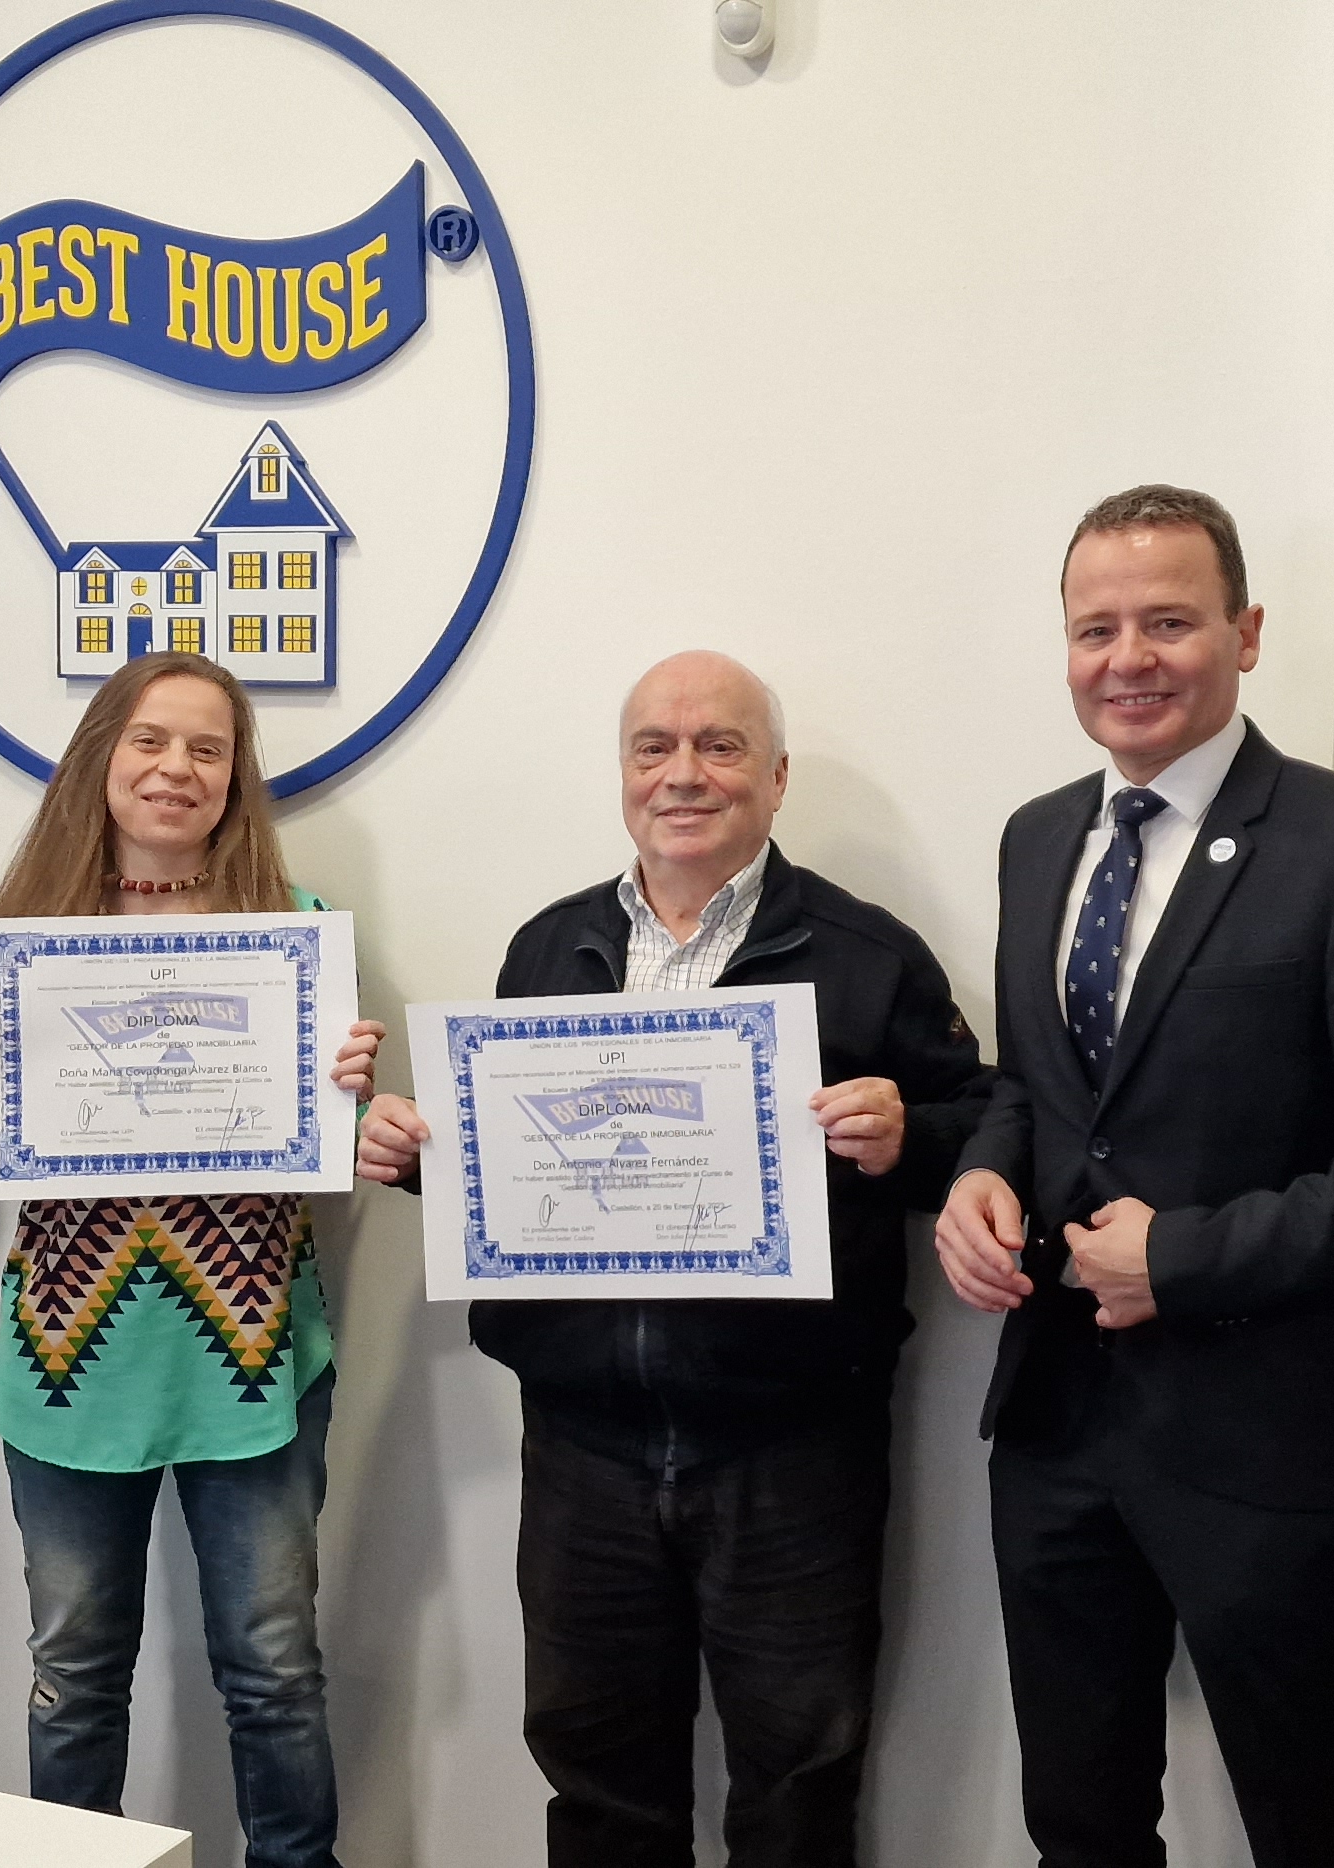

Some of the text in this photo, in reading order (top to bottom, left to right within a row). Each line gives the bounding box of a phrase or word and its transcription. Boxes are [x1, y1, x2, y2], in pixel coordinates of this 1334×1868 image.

[165, 232, 388, 363] HOUSE
[150, 968, 176, 980] UPI
[127, 1015, 200, 1027] DIPLOMA
[157, 1031, 170, 1039] de
[126, 1041, 137, 1049] LA
[140, 1040, 193, 1049] PROPIEDAD
[553, 1041, 562, 1049] DE
[643, 1037, 653, 1045] DE
[599, 1052, 626, 1065] UPI
[60, 1067, 88, 1077] Doña
[125, 1065, 187, 1077] Covadonga
[232, 1063, 268, 1074] Blanco
[579, 1102, 653, 1117] DIPLOMA
[610, 1121, 623, 1129] de
[564, 1133, 578, 1141] DE
[579, 1132, 592, 1141] LA
[593, 1130, 648, 1140] PROPIEDAD
[533, 1160, 556, 1170] Don
[559, 1159, 602, 1170] Antonio
[651, 1156, 710, 1167] Fernández
